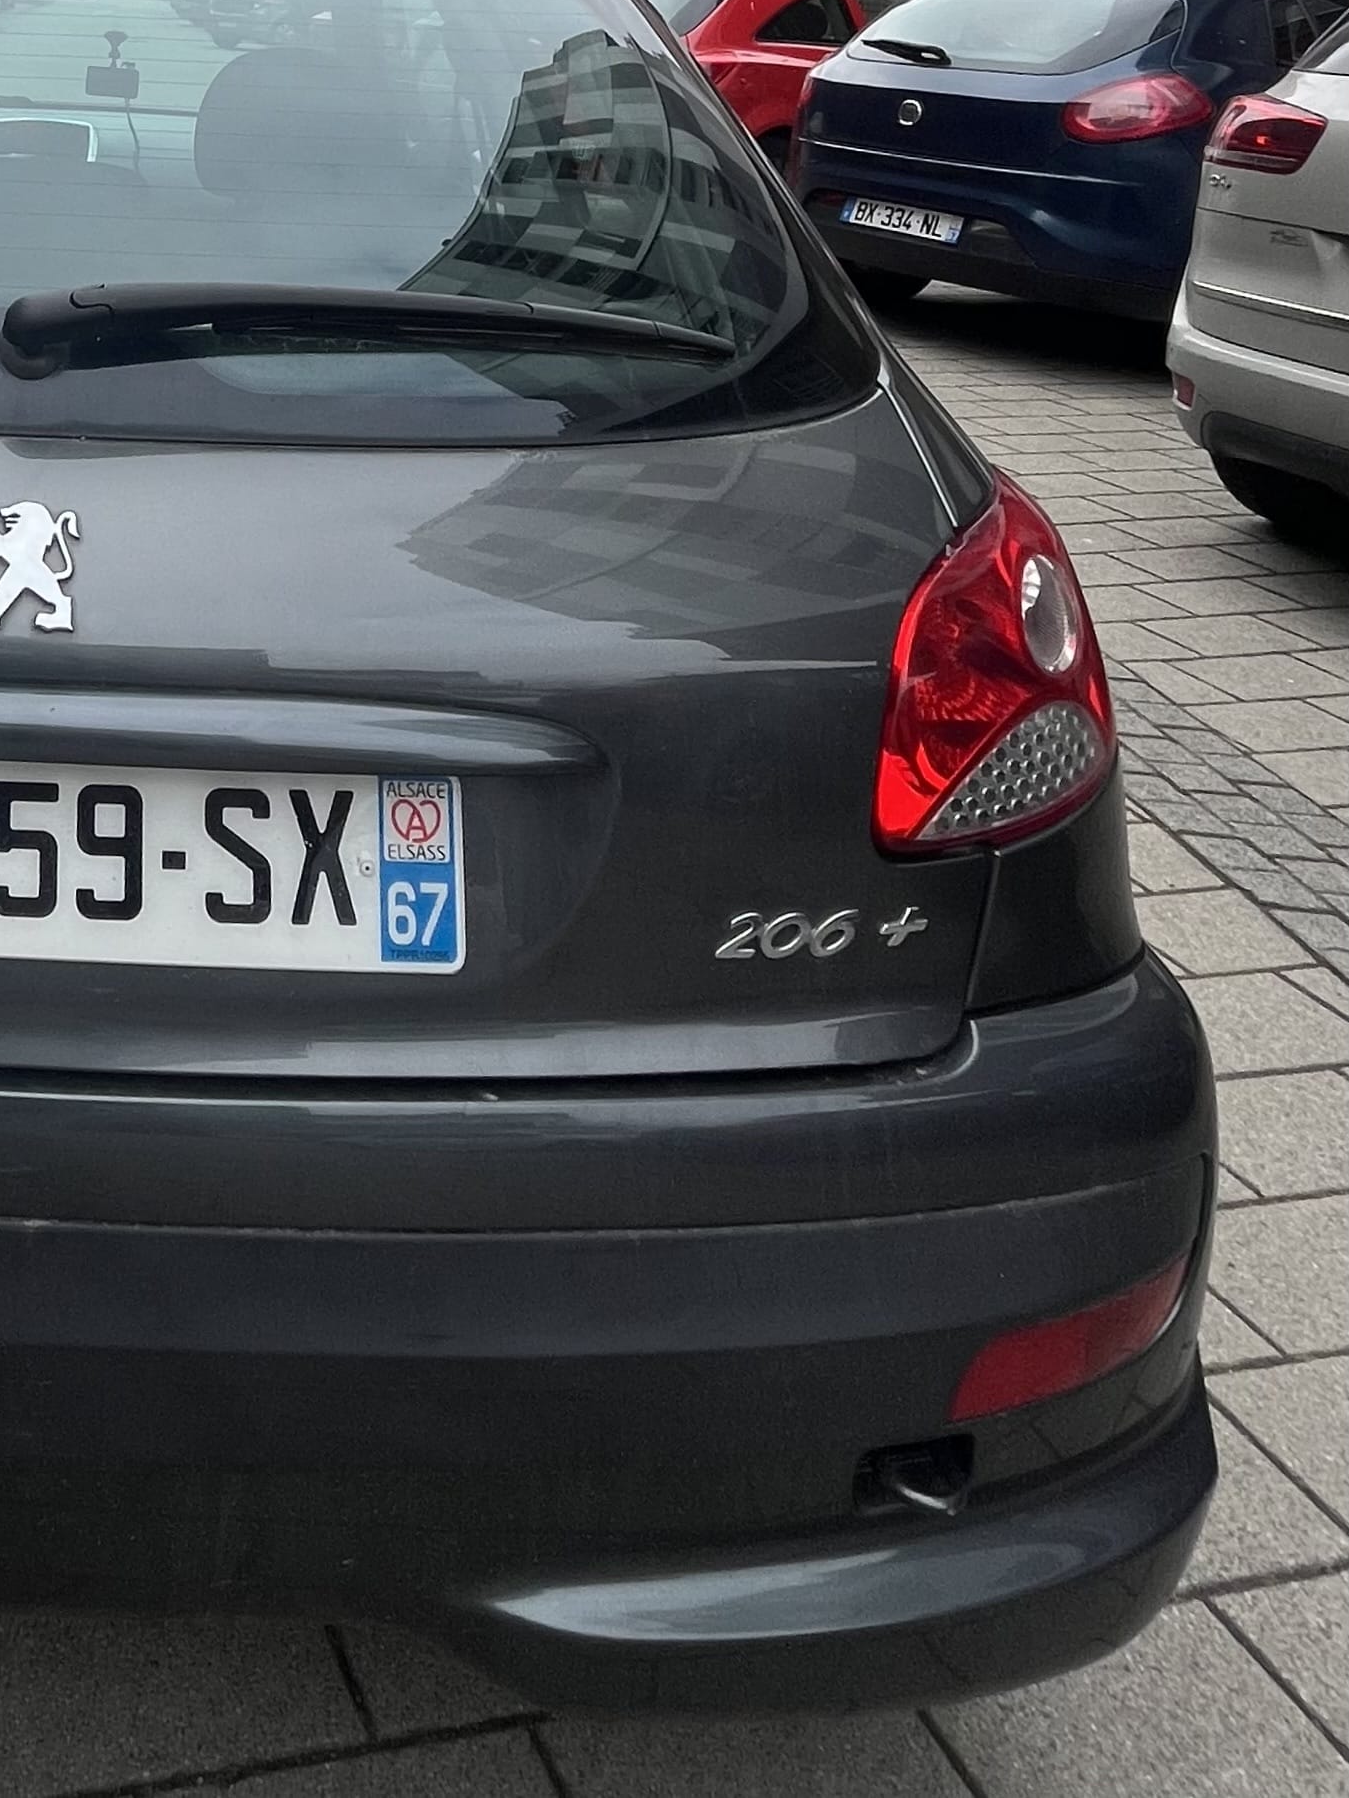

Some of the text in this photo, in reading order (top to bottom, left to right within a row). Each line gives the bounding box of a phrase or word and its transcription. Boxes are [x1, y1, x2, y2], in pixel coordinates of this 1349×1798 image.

[387, 781, 446, 799] ALSACE
[388, 844, 447, 862] ELSASS
[387, 880, 449, 947] 67
[715, 908, 859, 959] 206
